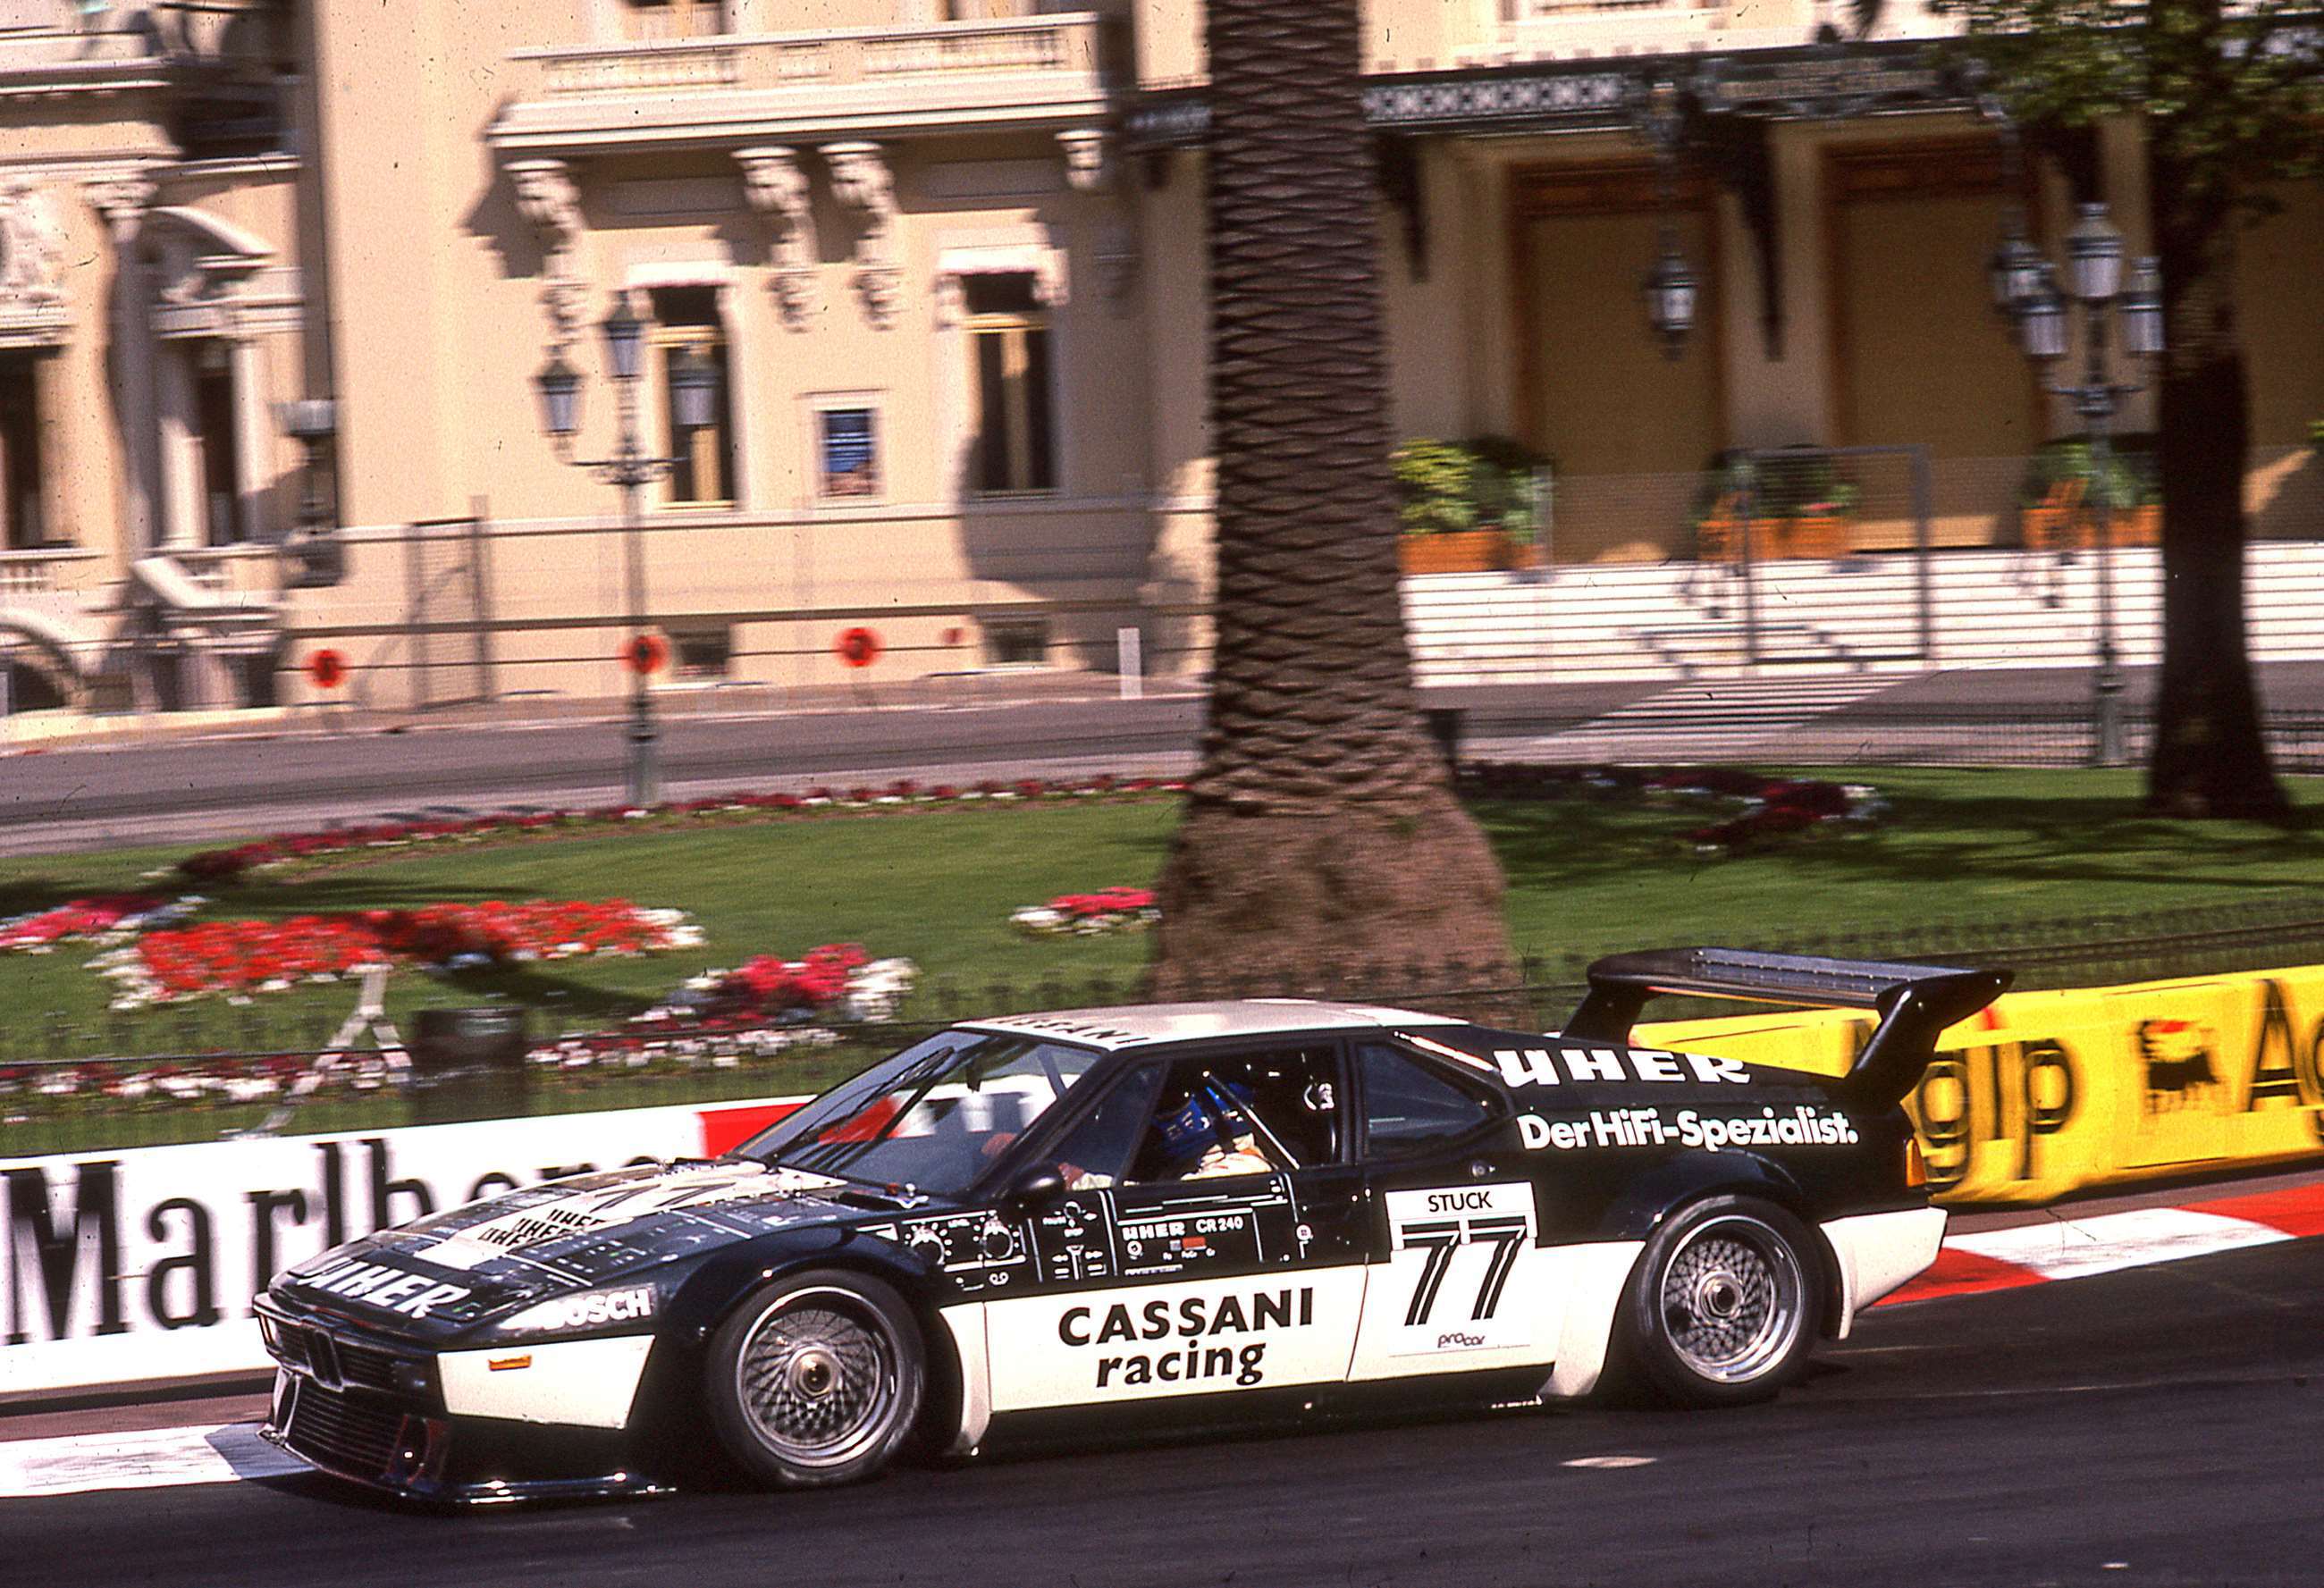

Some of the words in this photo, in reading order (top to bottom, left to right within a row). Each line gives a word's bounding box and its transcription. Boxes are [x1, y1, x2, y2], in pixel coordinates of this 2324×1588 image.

[1493, 1049, 1750, 1088] UHER
[2238, 979, 2324, 1147] A
[1517, 1113, 1589, 1150] Der
[1589, 1106, 1859, 1152] HiFi-Spezialist.
[1427, 1190, 1493, 1213] STUCK
[1122, 1221, 1186, 1241] UHER
[1195, 1218, 1217, 1234] CR
[1218, 1215, 1244, 1232] 240
[297, 1256, 472, 1319] UHER
[1401, 1214, 1527, 1326] 77
[1058, 1286, 1313, 1348] CASSANI
[1437, 1332, 1486, 1349] procar
[1096, 1339, 1267, 1387] racing
